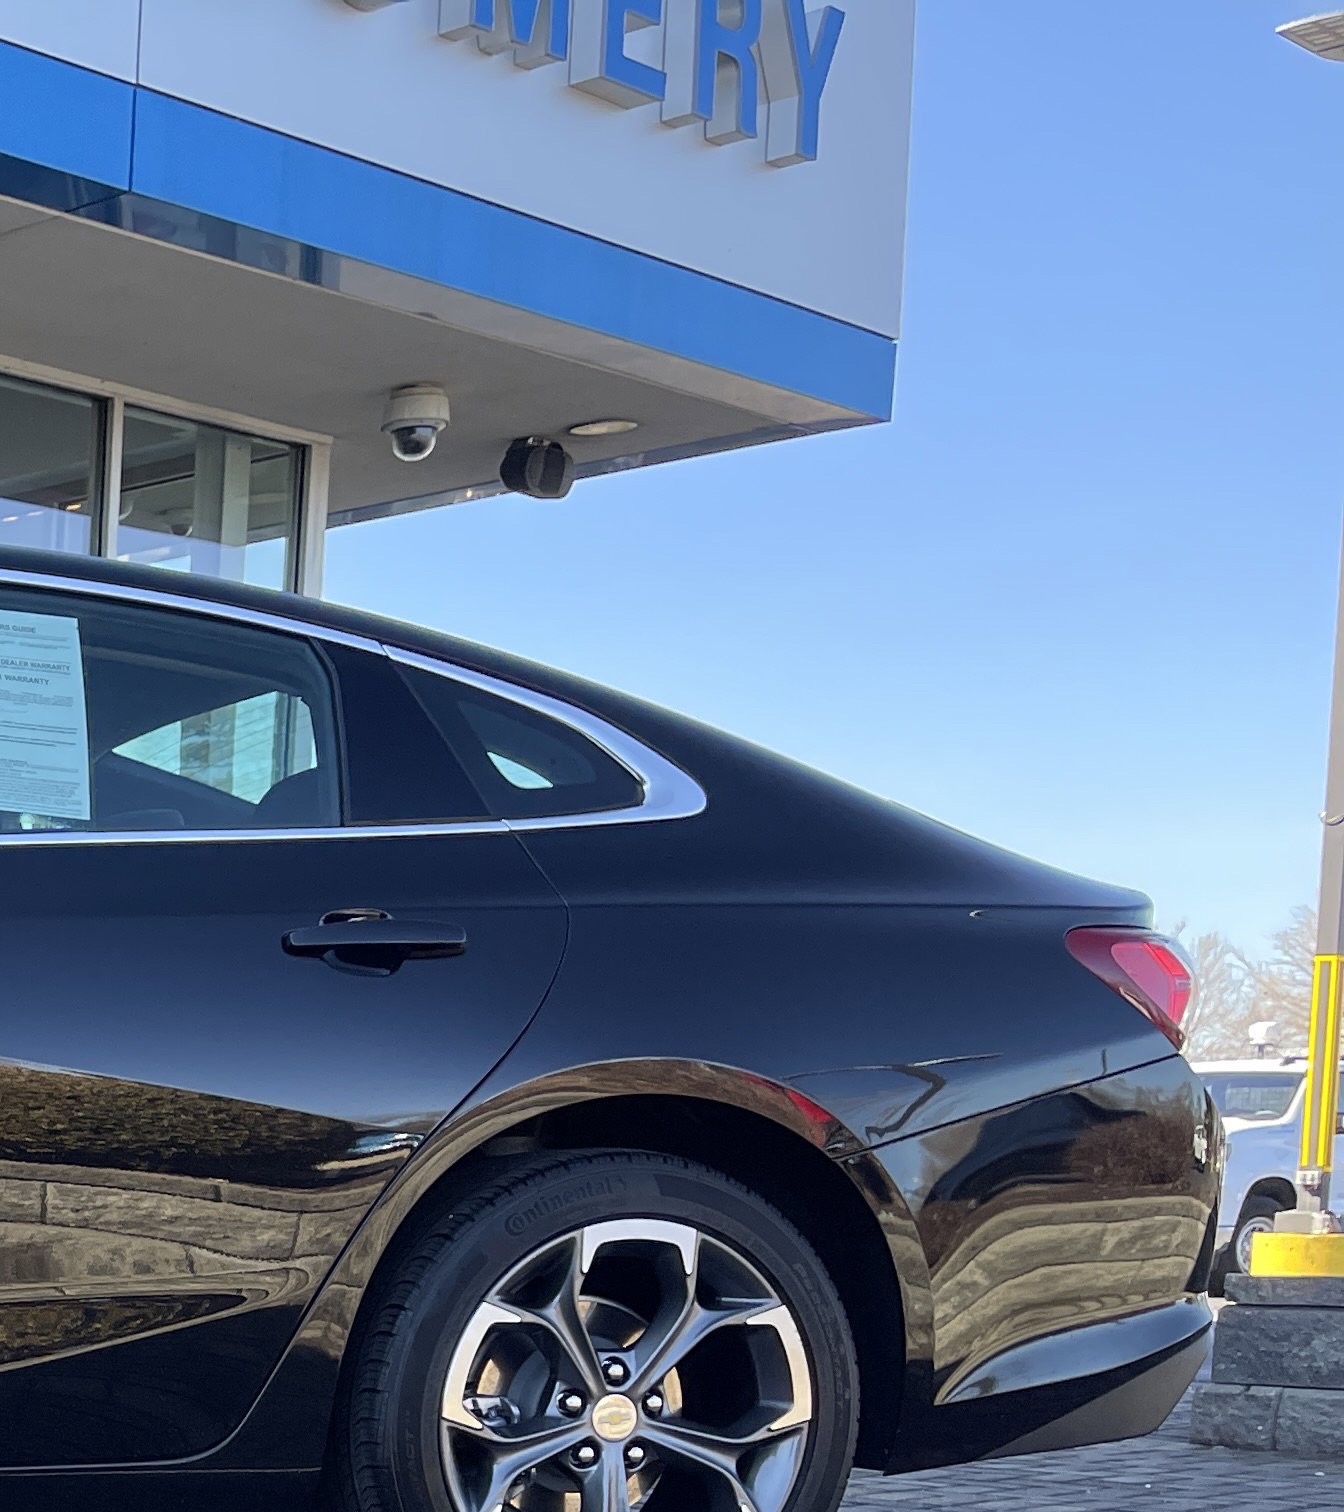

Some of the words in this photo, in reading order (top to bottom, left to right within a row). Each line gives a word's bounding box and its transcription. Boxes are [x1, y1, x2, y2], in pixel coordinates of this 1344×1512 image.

[11, 625, 36, 634] GUIDE
[1, 659, 29, 667] DEALER
[30, 662, 71, 671] WARRANTY
[4, 674, 50, 685] WARRANTY
[504, 1176, 613, 1236] Continental
